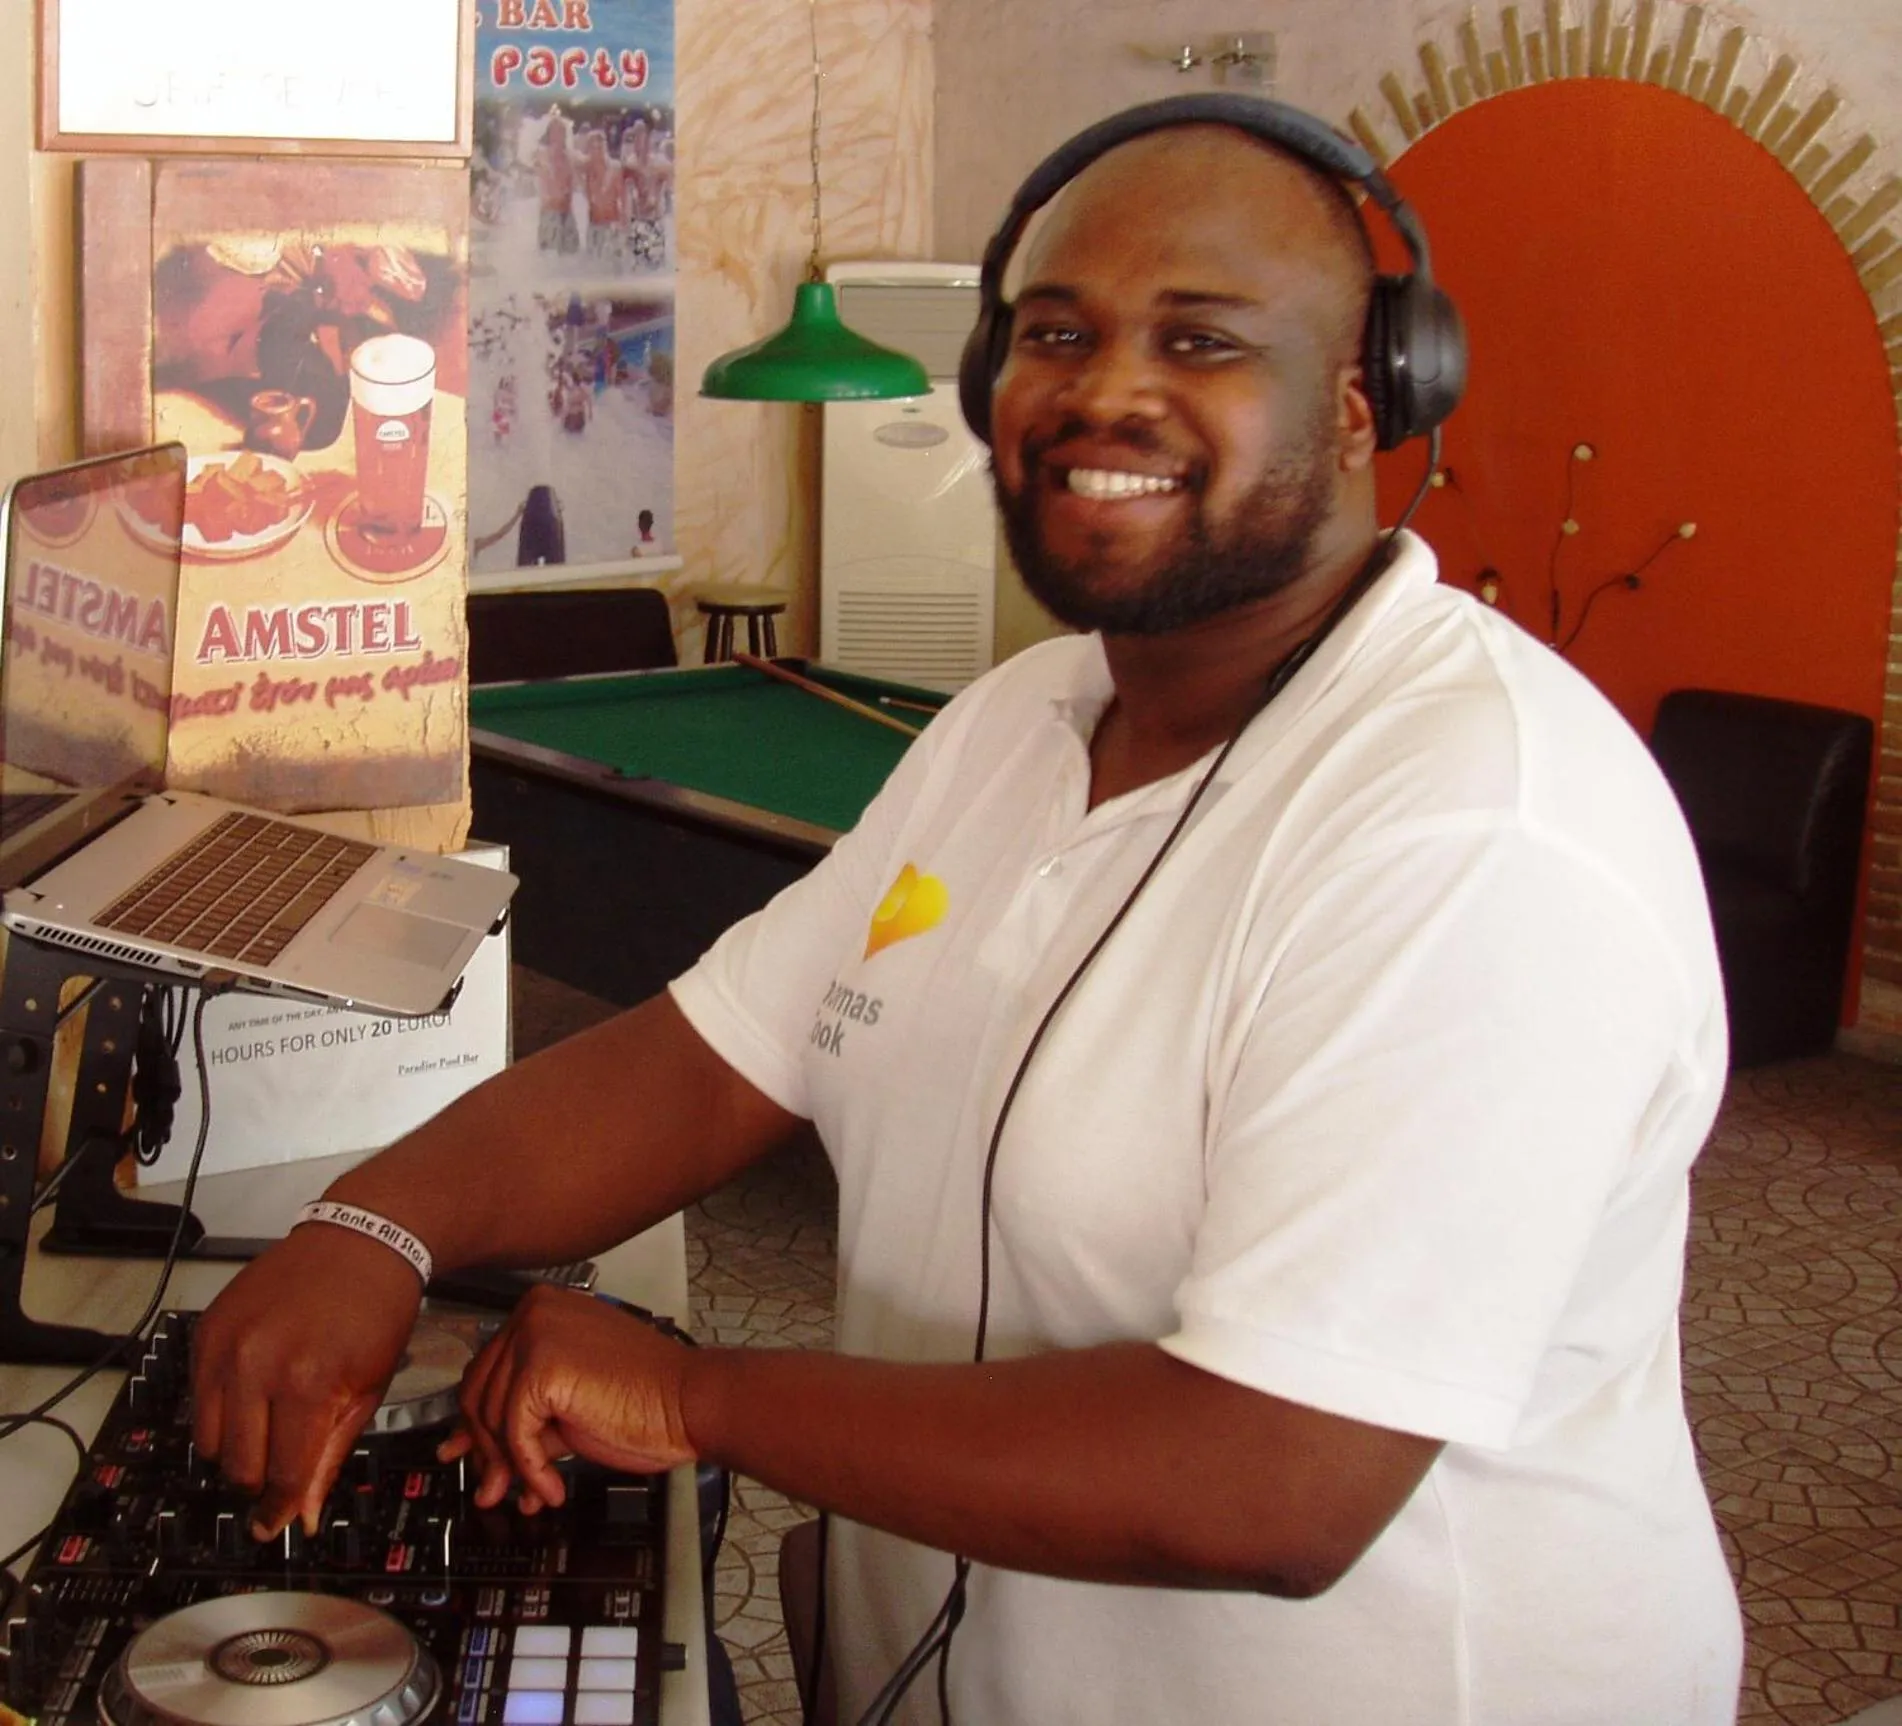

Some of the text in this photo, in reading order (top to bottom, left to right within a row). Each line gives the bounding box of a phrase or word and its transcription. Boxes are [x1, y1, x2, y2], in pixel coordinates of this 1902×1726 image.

[497, 0, 592, 31] BAR
[197, 599, 422, 665] AMSTEL
[211, 1040, 275, 1065] HOURS
[280, 1033, 316, 1054] FOR
[321, 1024, 367, 1047] ONLY
[371, 1019, 393, 1038] 20
[331, 1207, 376, 1231] Zante
[378, 1223, 401, 1243] All
